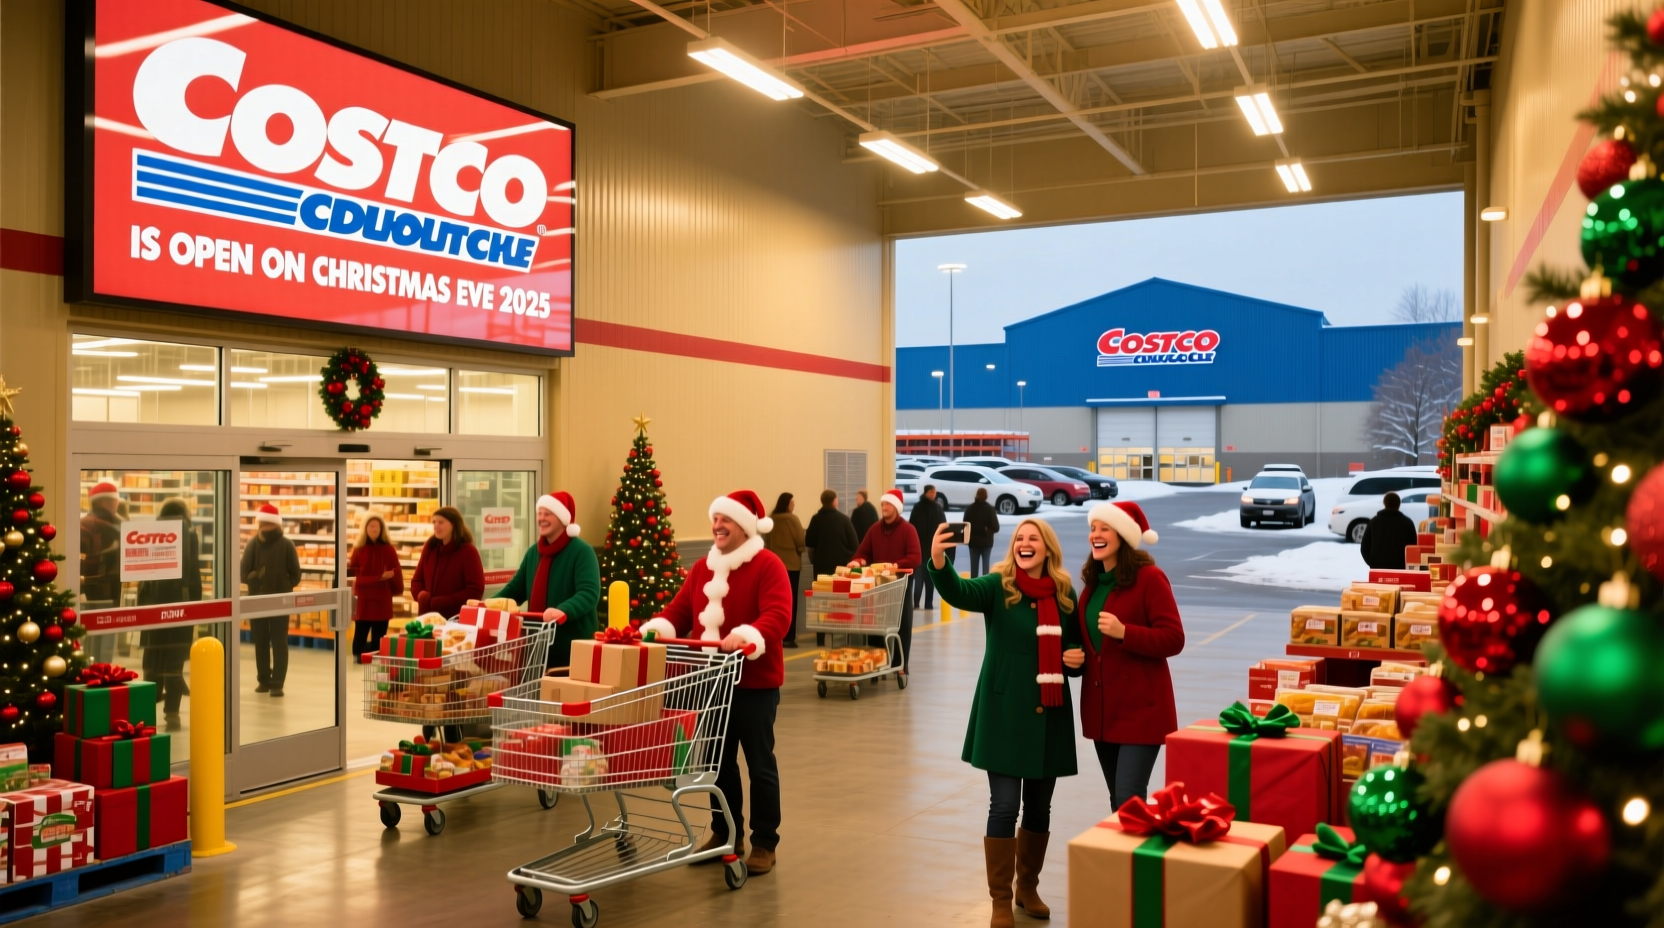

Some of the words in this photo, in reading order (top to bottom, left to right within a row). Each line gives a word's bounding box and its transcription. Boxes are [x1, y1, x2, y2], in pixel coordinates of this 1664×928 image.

[133, 37, 547, 228] COSTCO
[130, 225, 161, 261] IS
[169, 232, 254, 275] OPEN
[261, 247, 305, 283] ON
[312, 256, 450, 304] CHRISTMAS
[456, 279, 494, 310] EVE
[499, 286, 550, 319] 2025
[1097, 329, 1220, 354] COSTCO
